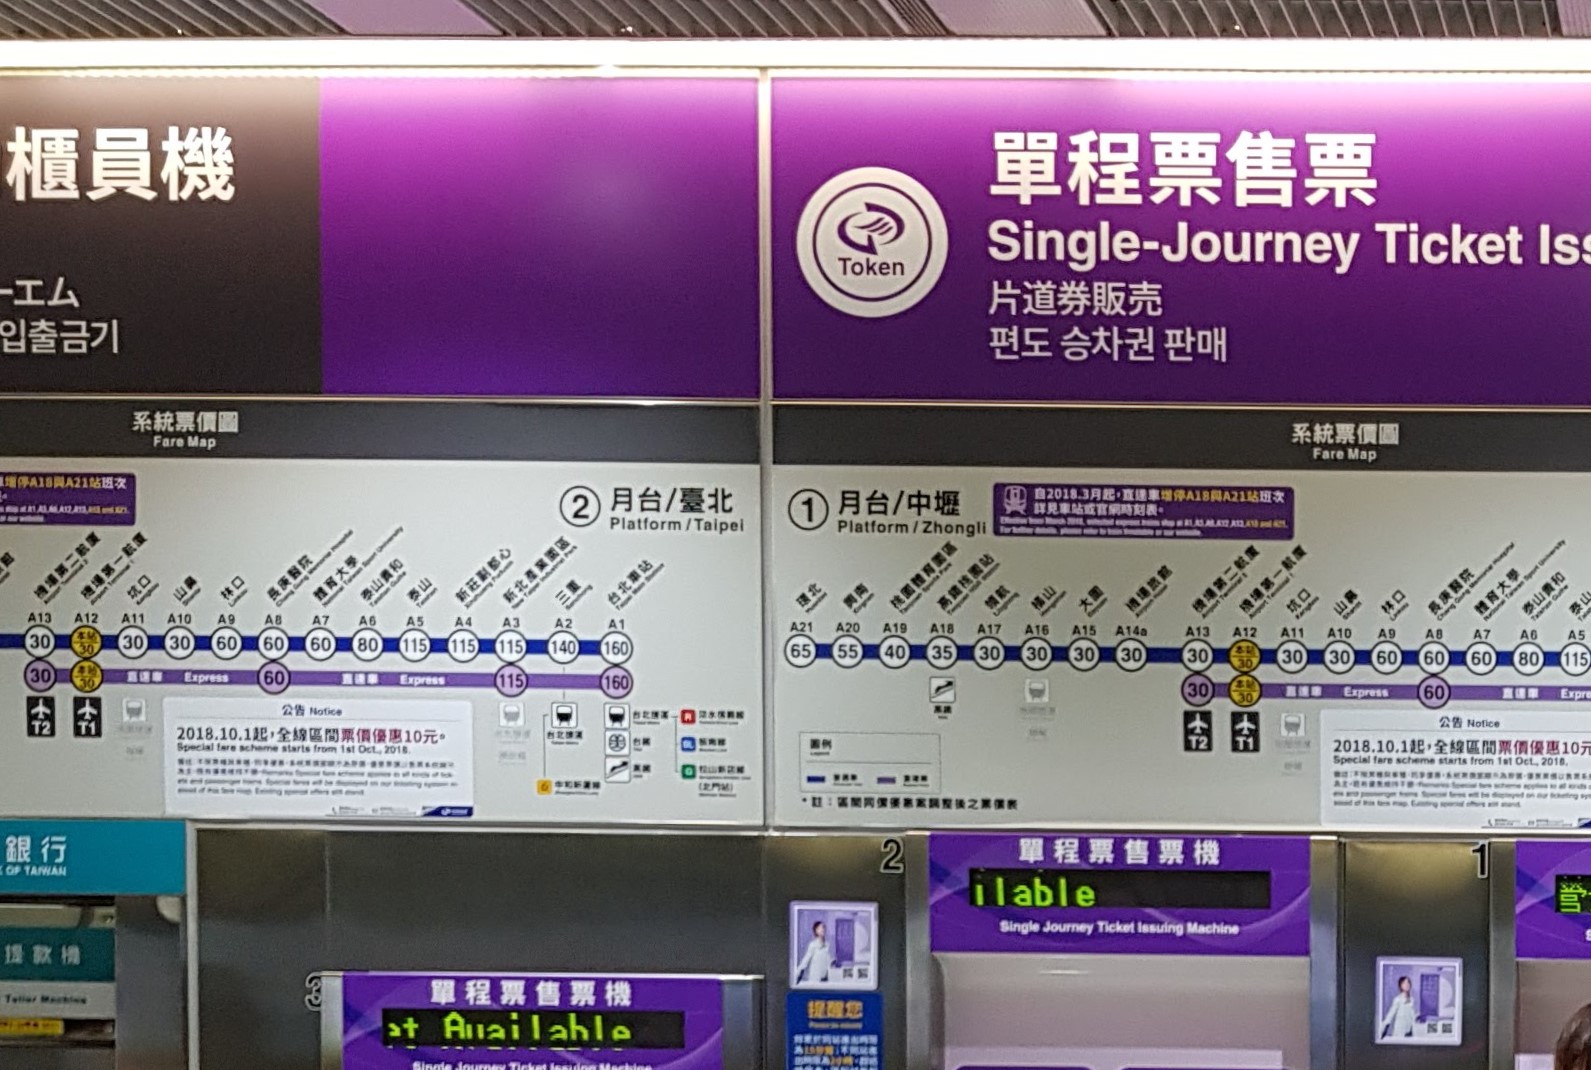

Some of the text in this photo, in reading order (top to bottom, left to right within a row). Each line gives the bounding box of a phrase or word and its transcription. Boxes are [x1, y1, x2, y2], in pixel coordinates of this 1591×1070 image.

[6, 126, 234, 200] 櫃員機
[991, 130, 1377, 207] 單程票售票
[989, 220, 1360, 274] Single-Journey
[1375, 223, 1522, 264] Ticket
[838, 257, 904, 277] Token
[989, 280, 1162, 316] 片道券販売
[990, 326, 1226, 362] 편도 승차권 판매
[133, 411, 238, 432] 系統票價圖
[154, 436, 216, 450] Fare Map
[1292, 423, 1399, 444] 系統票價圖
[1313, 448, 1376, 462] Fare Map
[573, 494, 589, 519] 2
[612, 487, 733, 513] 月台/臺北
[839, 490, 960, 516] 月台/中壢
[838, 520, 908, 533] Platform
[923, 521, 986, 537] Zhongli
[28, 612, 51, 627] A13
[790, 622, 812, 636] A21
[1426, 629, 1442, 642] A8
[499, 640, 523, 653] 115
[604, 641, 629, 655] 160
[1188, 735, 1208, 749] T2
[1236, 736, 1253, 750] T1
[879, 837, 906, 875] 2
[1019, 838, 1219, 865] 單程票售票機
[1472, 841, 1490, 879] 1
[1000, 920, 1239, 936] Single Journey Ticket Issuing Machine
[431, 979, 631, 1006] 單程票售票機
